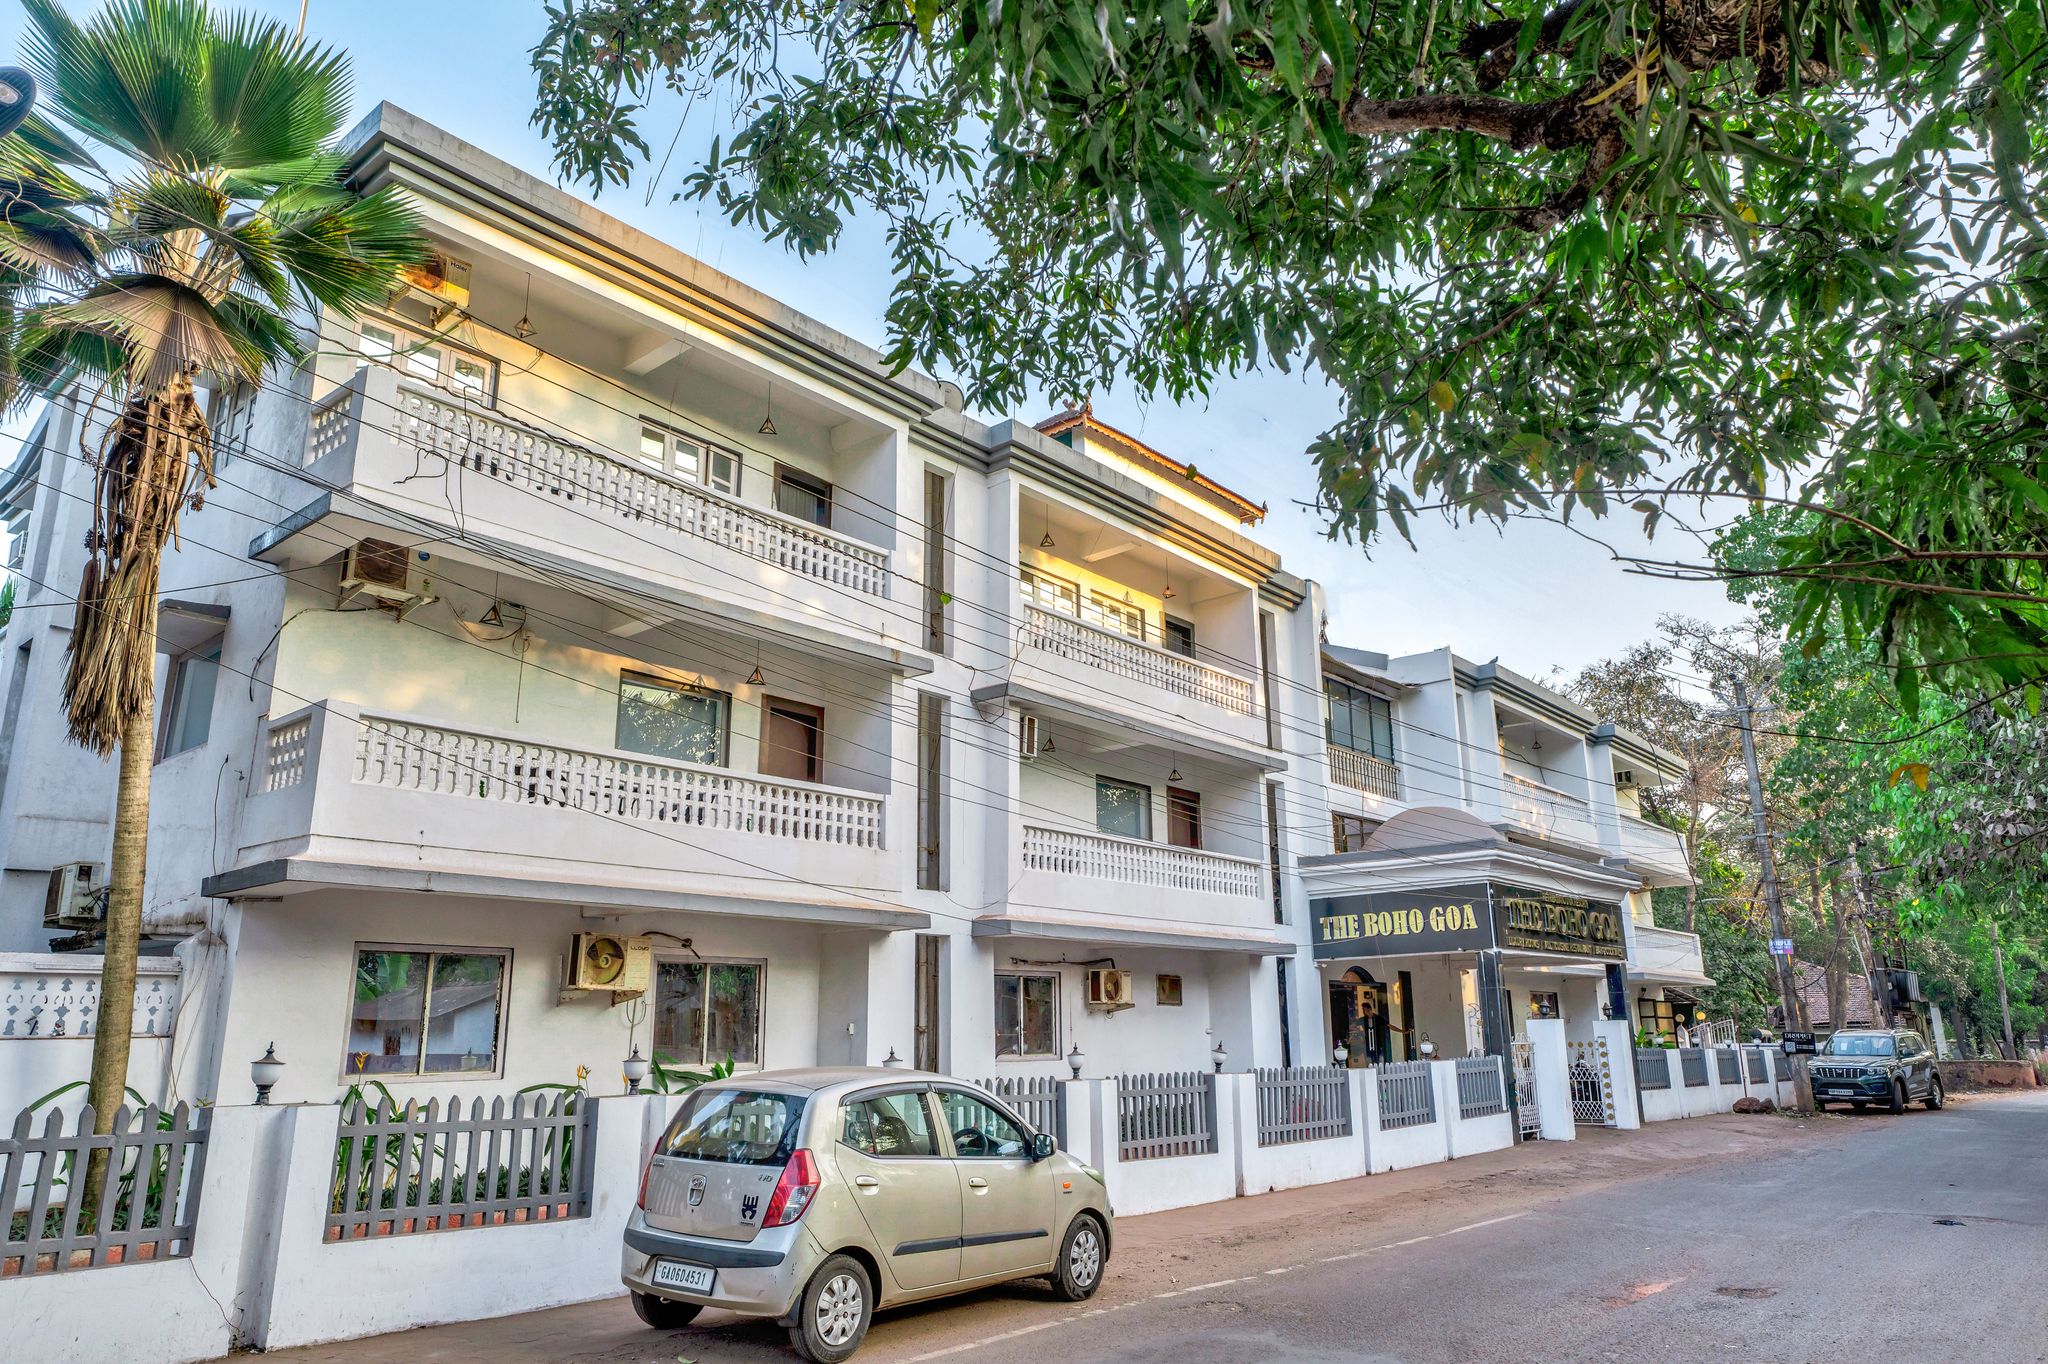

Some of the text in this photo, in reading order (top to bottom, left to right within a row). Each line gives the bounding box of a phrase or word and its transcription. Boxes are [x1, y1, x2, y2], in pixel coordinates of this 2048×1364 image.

[451, 261, 467, 272] Haier
[1320, 904, 1478, 940] THE BOHO GOA
[1504, 898, 1542, 931] THE
[1543, 904, 1588, 938] BOHO
[1589, 911, 1620, 941] GOA
[661, 1266, 706, 1286] GA06D4531
